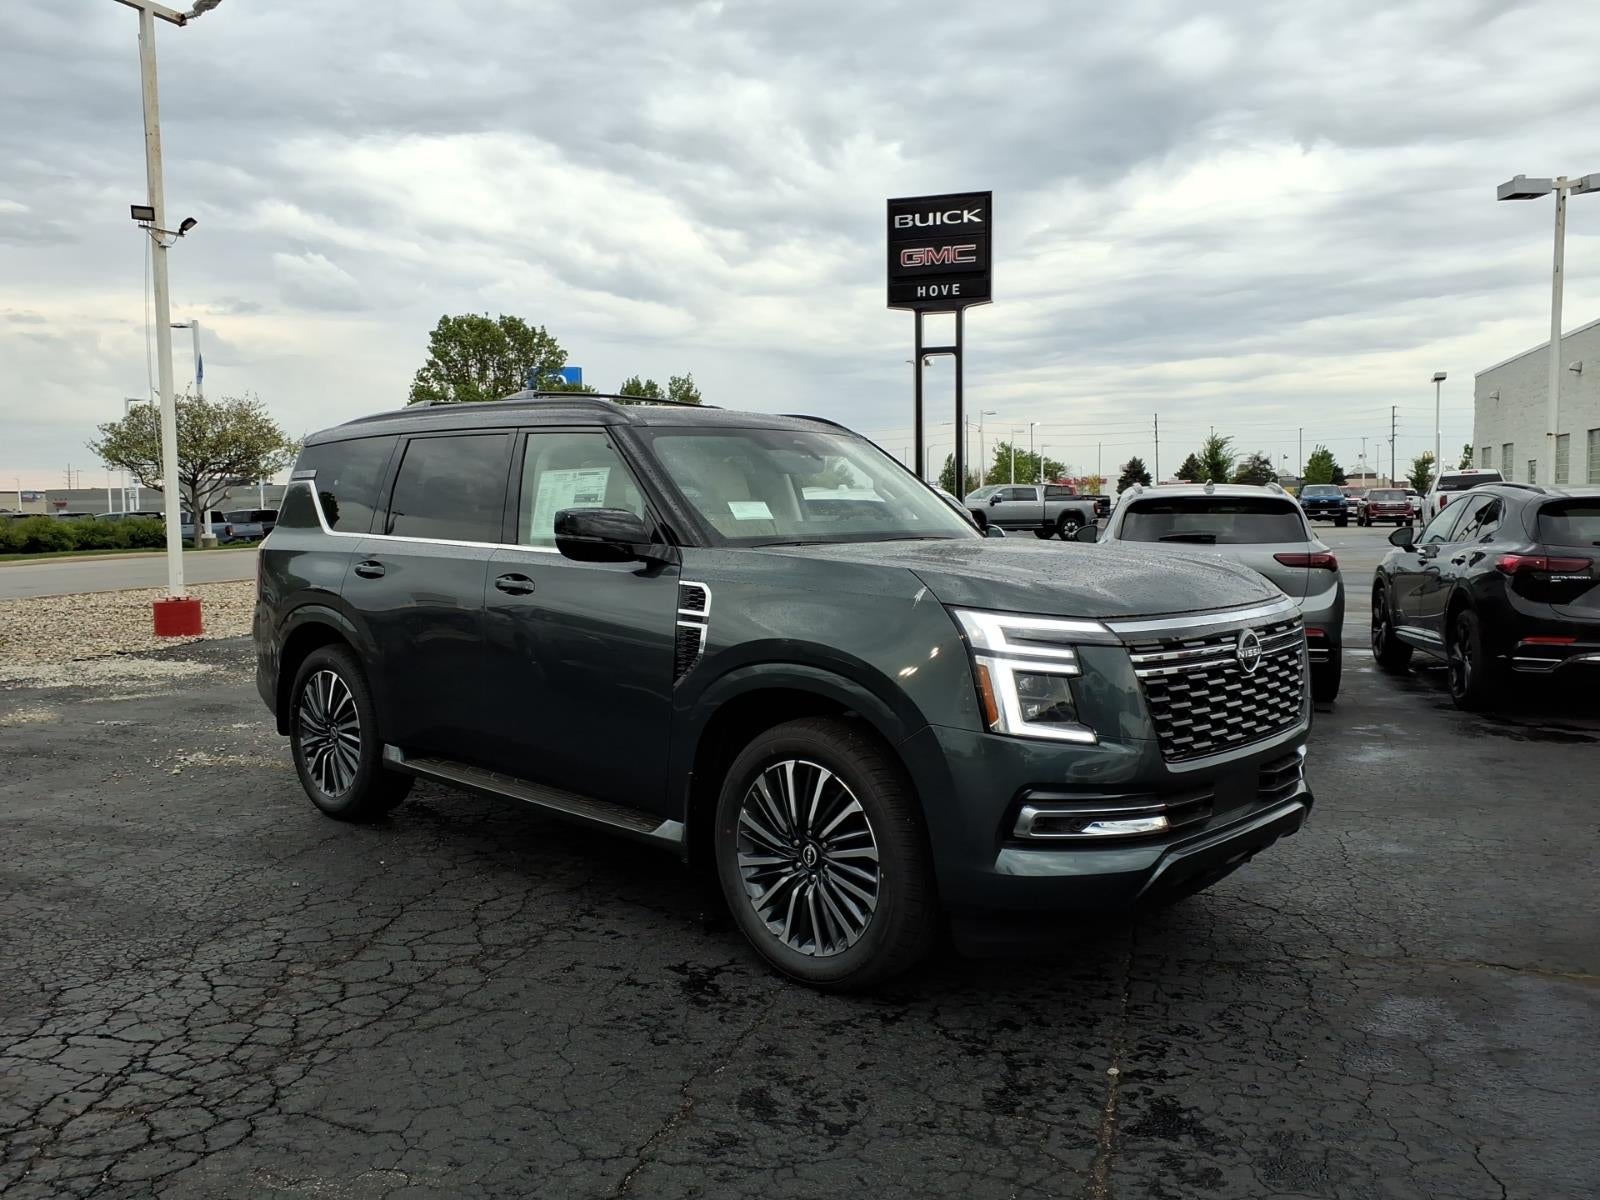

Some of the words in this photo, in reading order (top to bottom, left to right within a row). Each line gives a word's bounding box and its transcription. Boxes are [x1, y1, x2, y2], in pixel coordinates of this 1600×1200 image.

[894, 208, 983, 229] BUICK
[900, 244, 977, 268] GMC
[917, 283, 961, 297] HOVE
